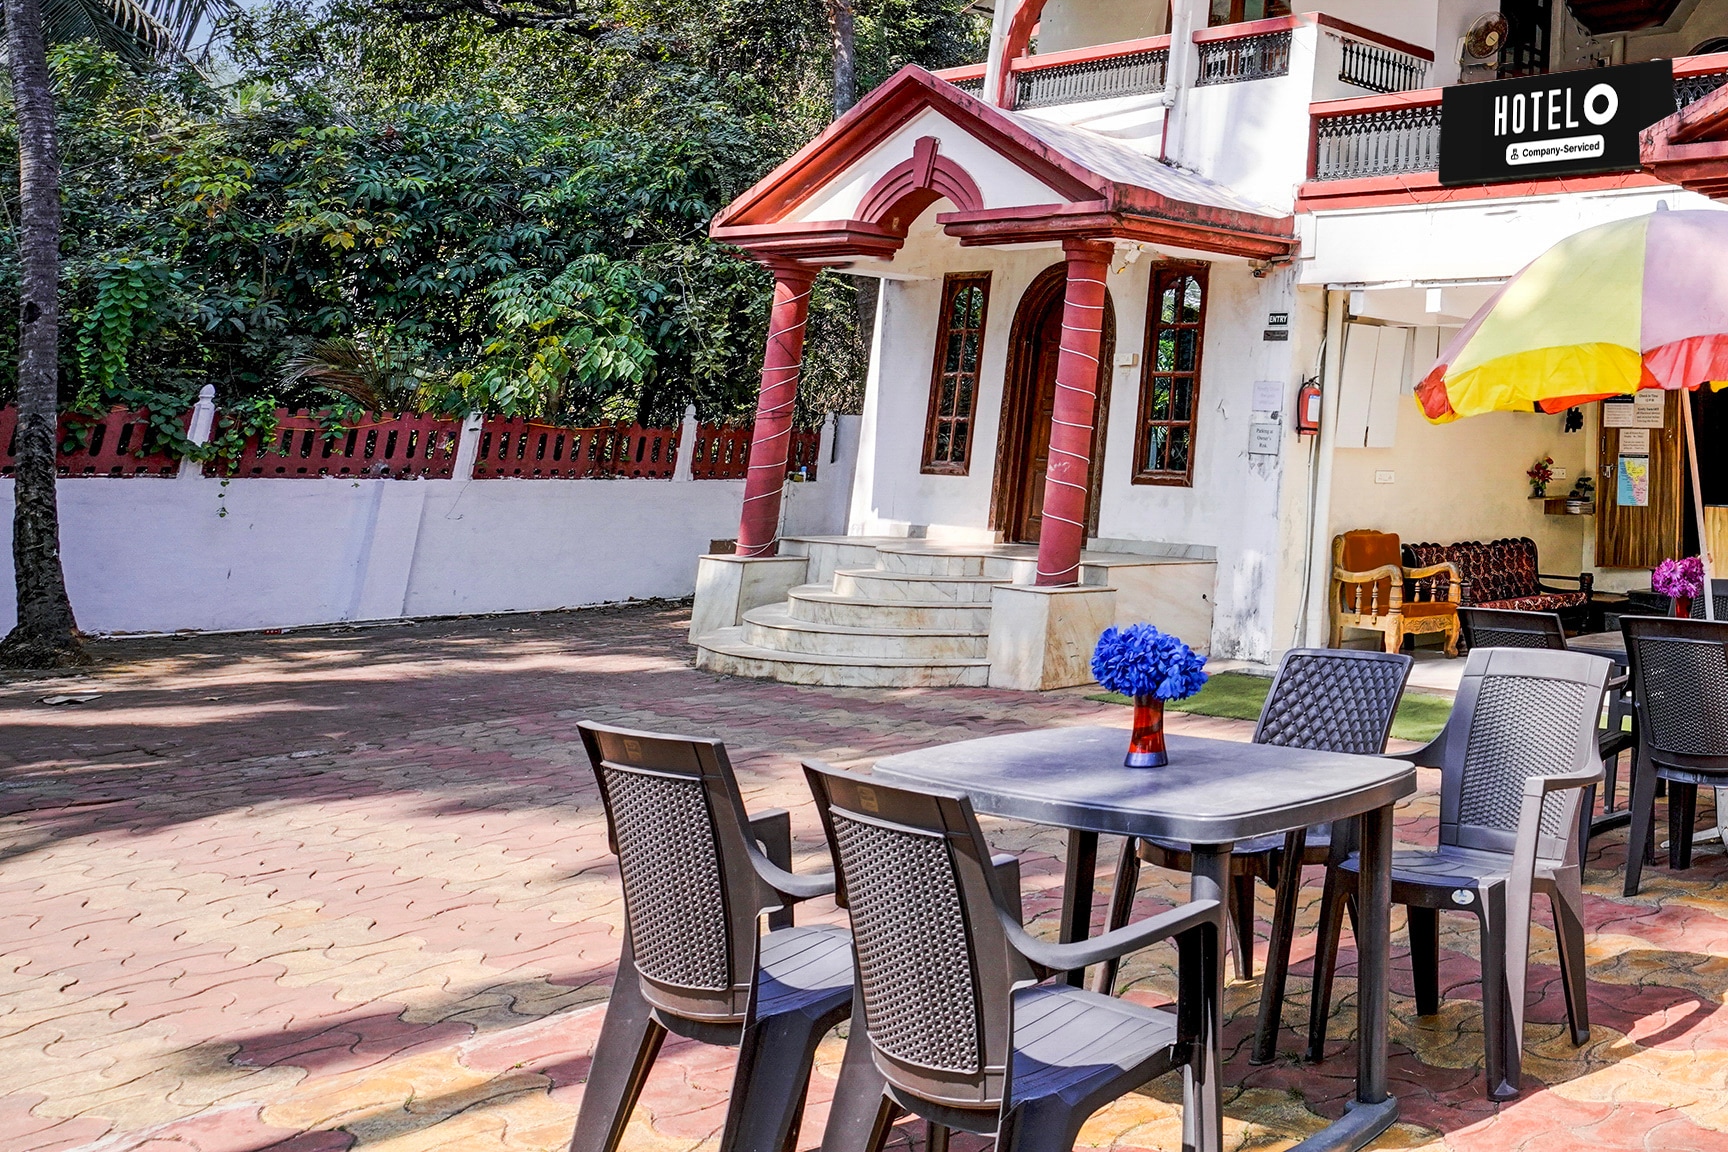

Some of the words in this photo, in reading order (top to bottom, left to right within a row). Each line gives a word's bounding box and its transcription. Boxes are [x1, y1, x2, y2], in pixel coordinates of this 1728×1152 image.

[1494, 87, 1579, 136] HOTEL
[1522, 141, 1600, 158] Company-Serviced
[1269, 315, 1287, 323] ENTRY
